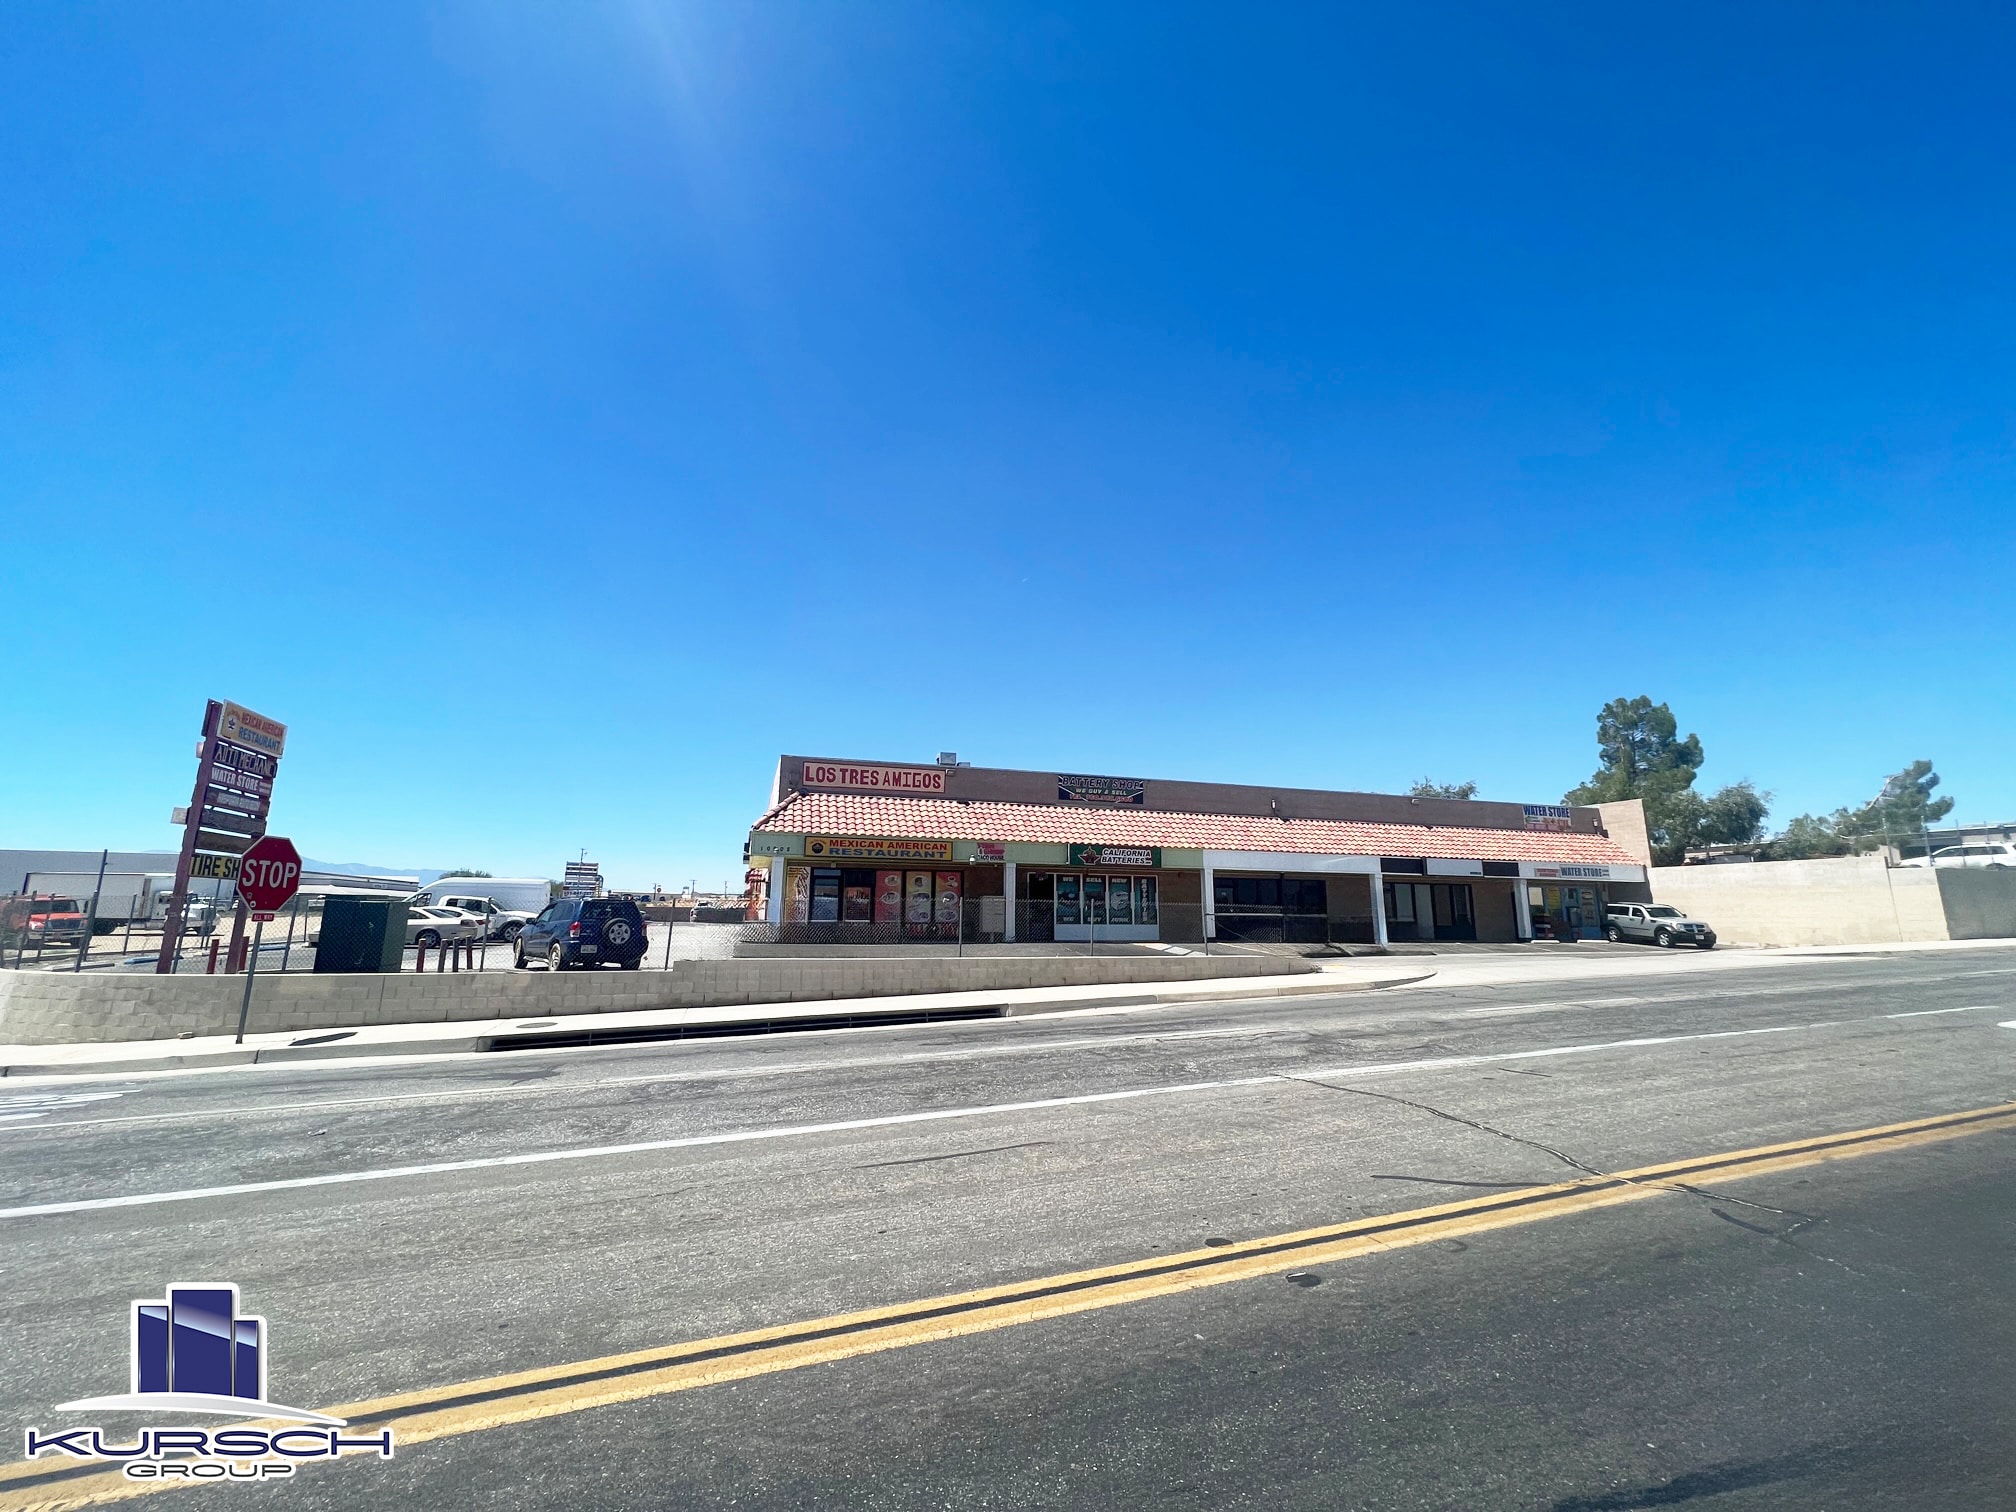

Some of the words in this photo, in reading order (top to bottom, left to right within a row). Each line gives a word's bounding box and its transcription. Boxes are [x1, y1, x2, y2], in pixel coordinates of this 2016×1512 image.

[239, 727, 281, 752] RESTAURANT
[215, 745, 239, 766] AUTO
[211, 767, 237, 785] WATER
[236, 774, 259, 791] STORE
[805, 766, 836, 782] LOS
[839, 768, 880, 785] TRES
[882, 771, 941, 789] AMIGOS
[1062, 776, 1110, 788] BATTERY
[1111, 779, 1140, 790] SHOP
[1523, 806, 1547, 816] WATER
[1548, 807, 1570, 818] STORE
[829, 840, 884, 849] MEXICAN
[887, 841, 948, 851] AMERICAN
[829, 848, 947, 859] RESTAURANT
[1101, 856, 1145, 864] BATTERIES
[1102, 848, 1151, 858] CALIFORNIA
[191, 854, 222, 877] TIRE
[222, 858, 241, 878] SH
[1560, 867, 1582, 876] WATER
[1583, 868, 1602, 877] STORE
[242, 858, 298, 889] STOP
